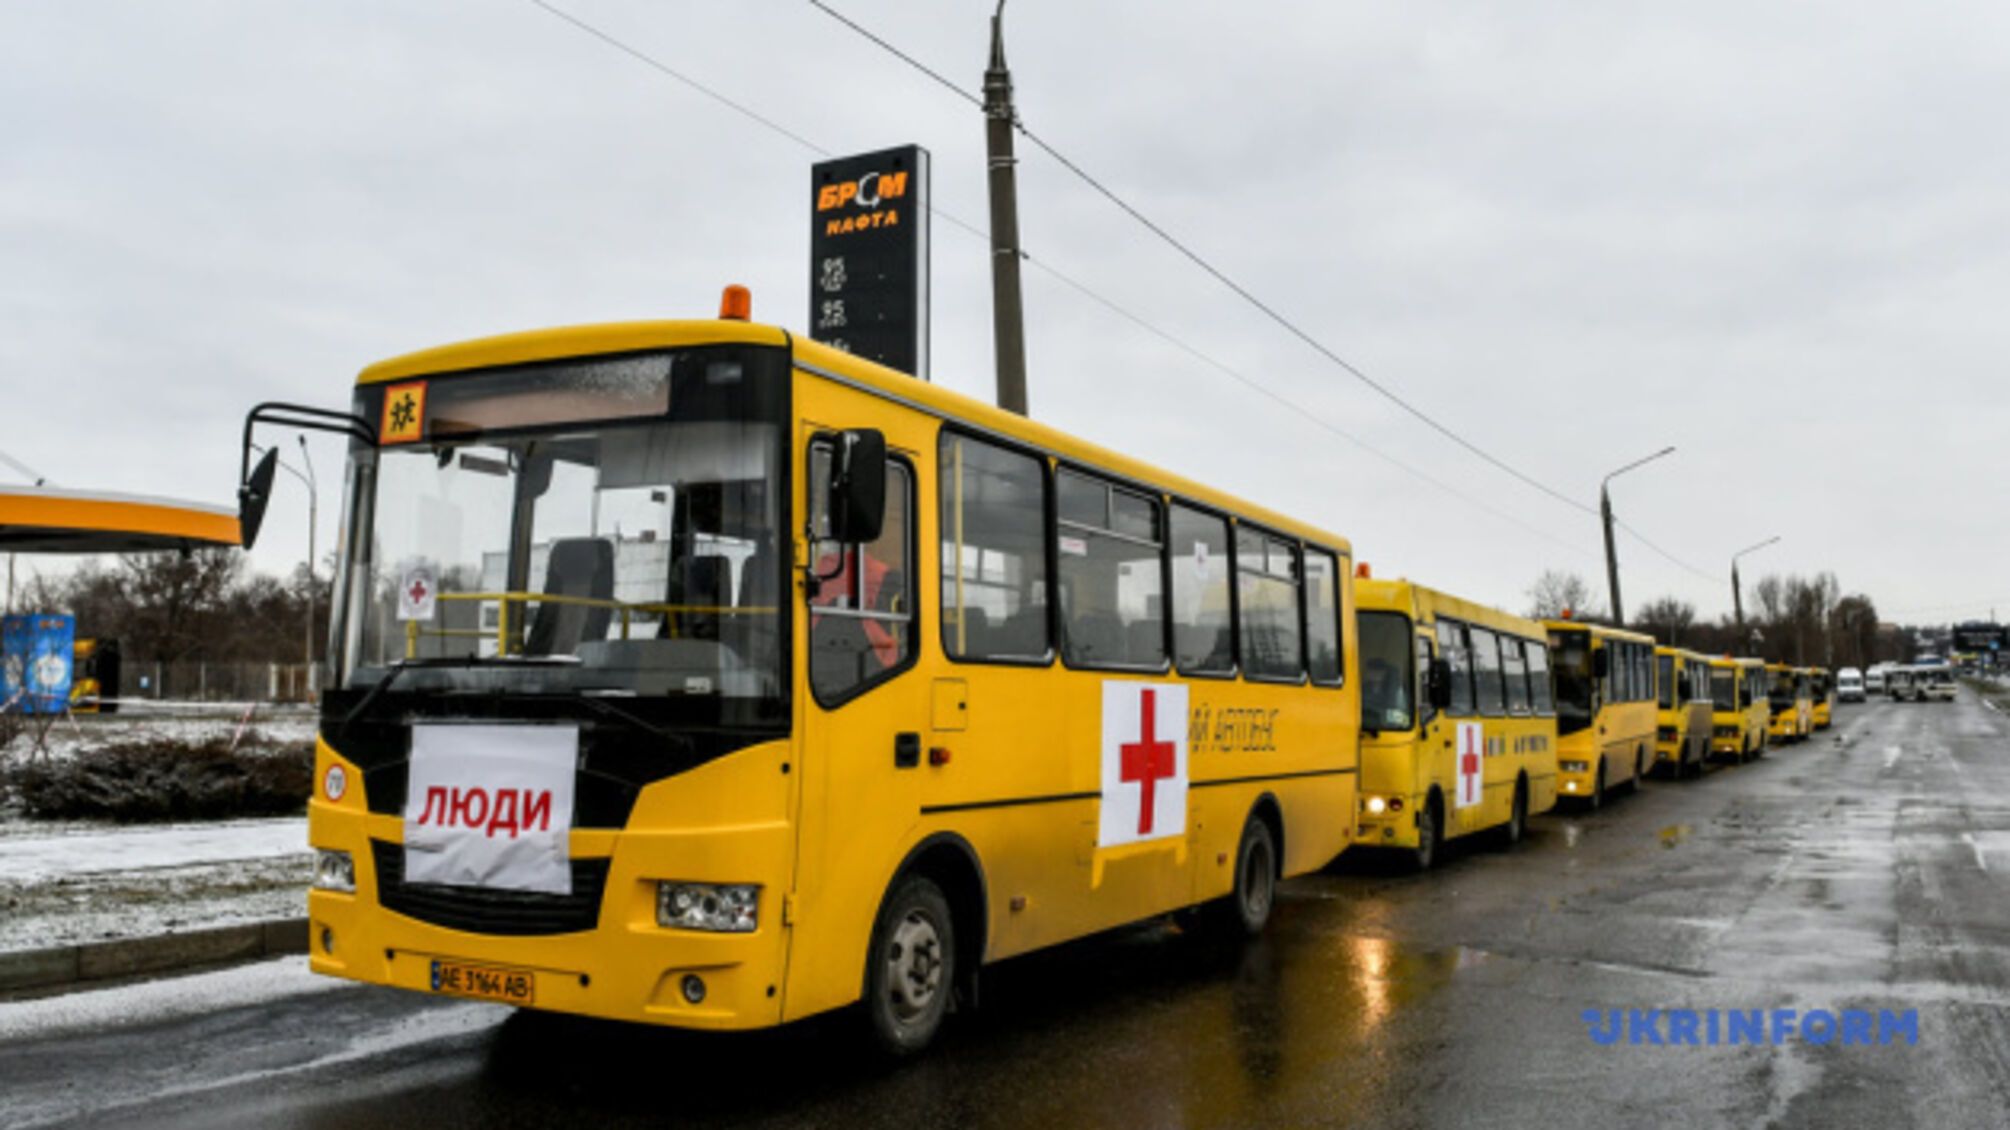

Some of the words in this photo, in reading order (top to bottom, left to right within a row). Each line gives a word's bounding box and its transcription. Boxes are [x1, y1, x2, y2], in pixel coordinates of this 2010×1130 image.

[817, 172, 908, 212] БРСМ
[826, 210, 898, 236] НАФТА
[418, 786, 553, 839] ЛЮДИ
